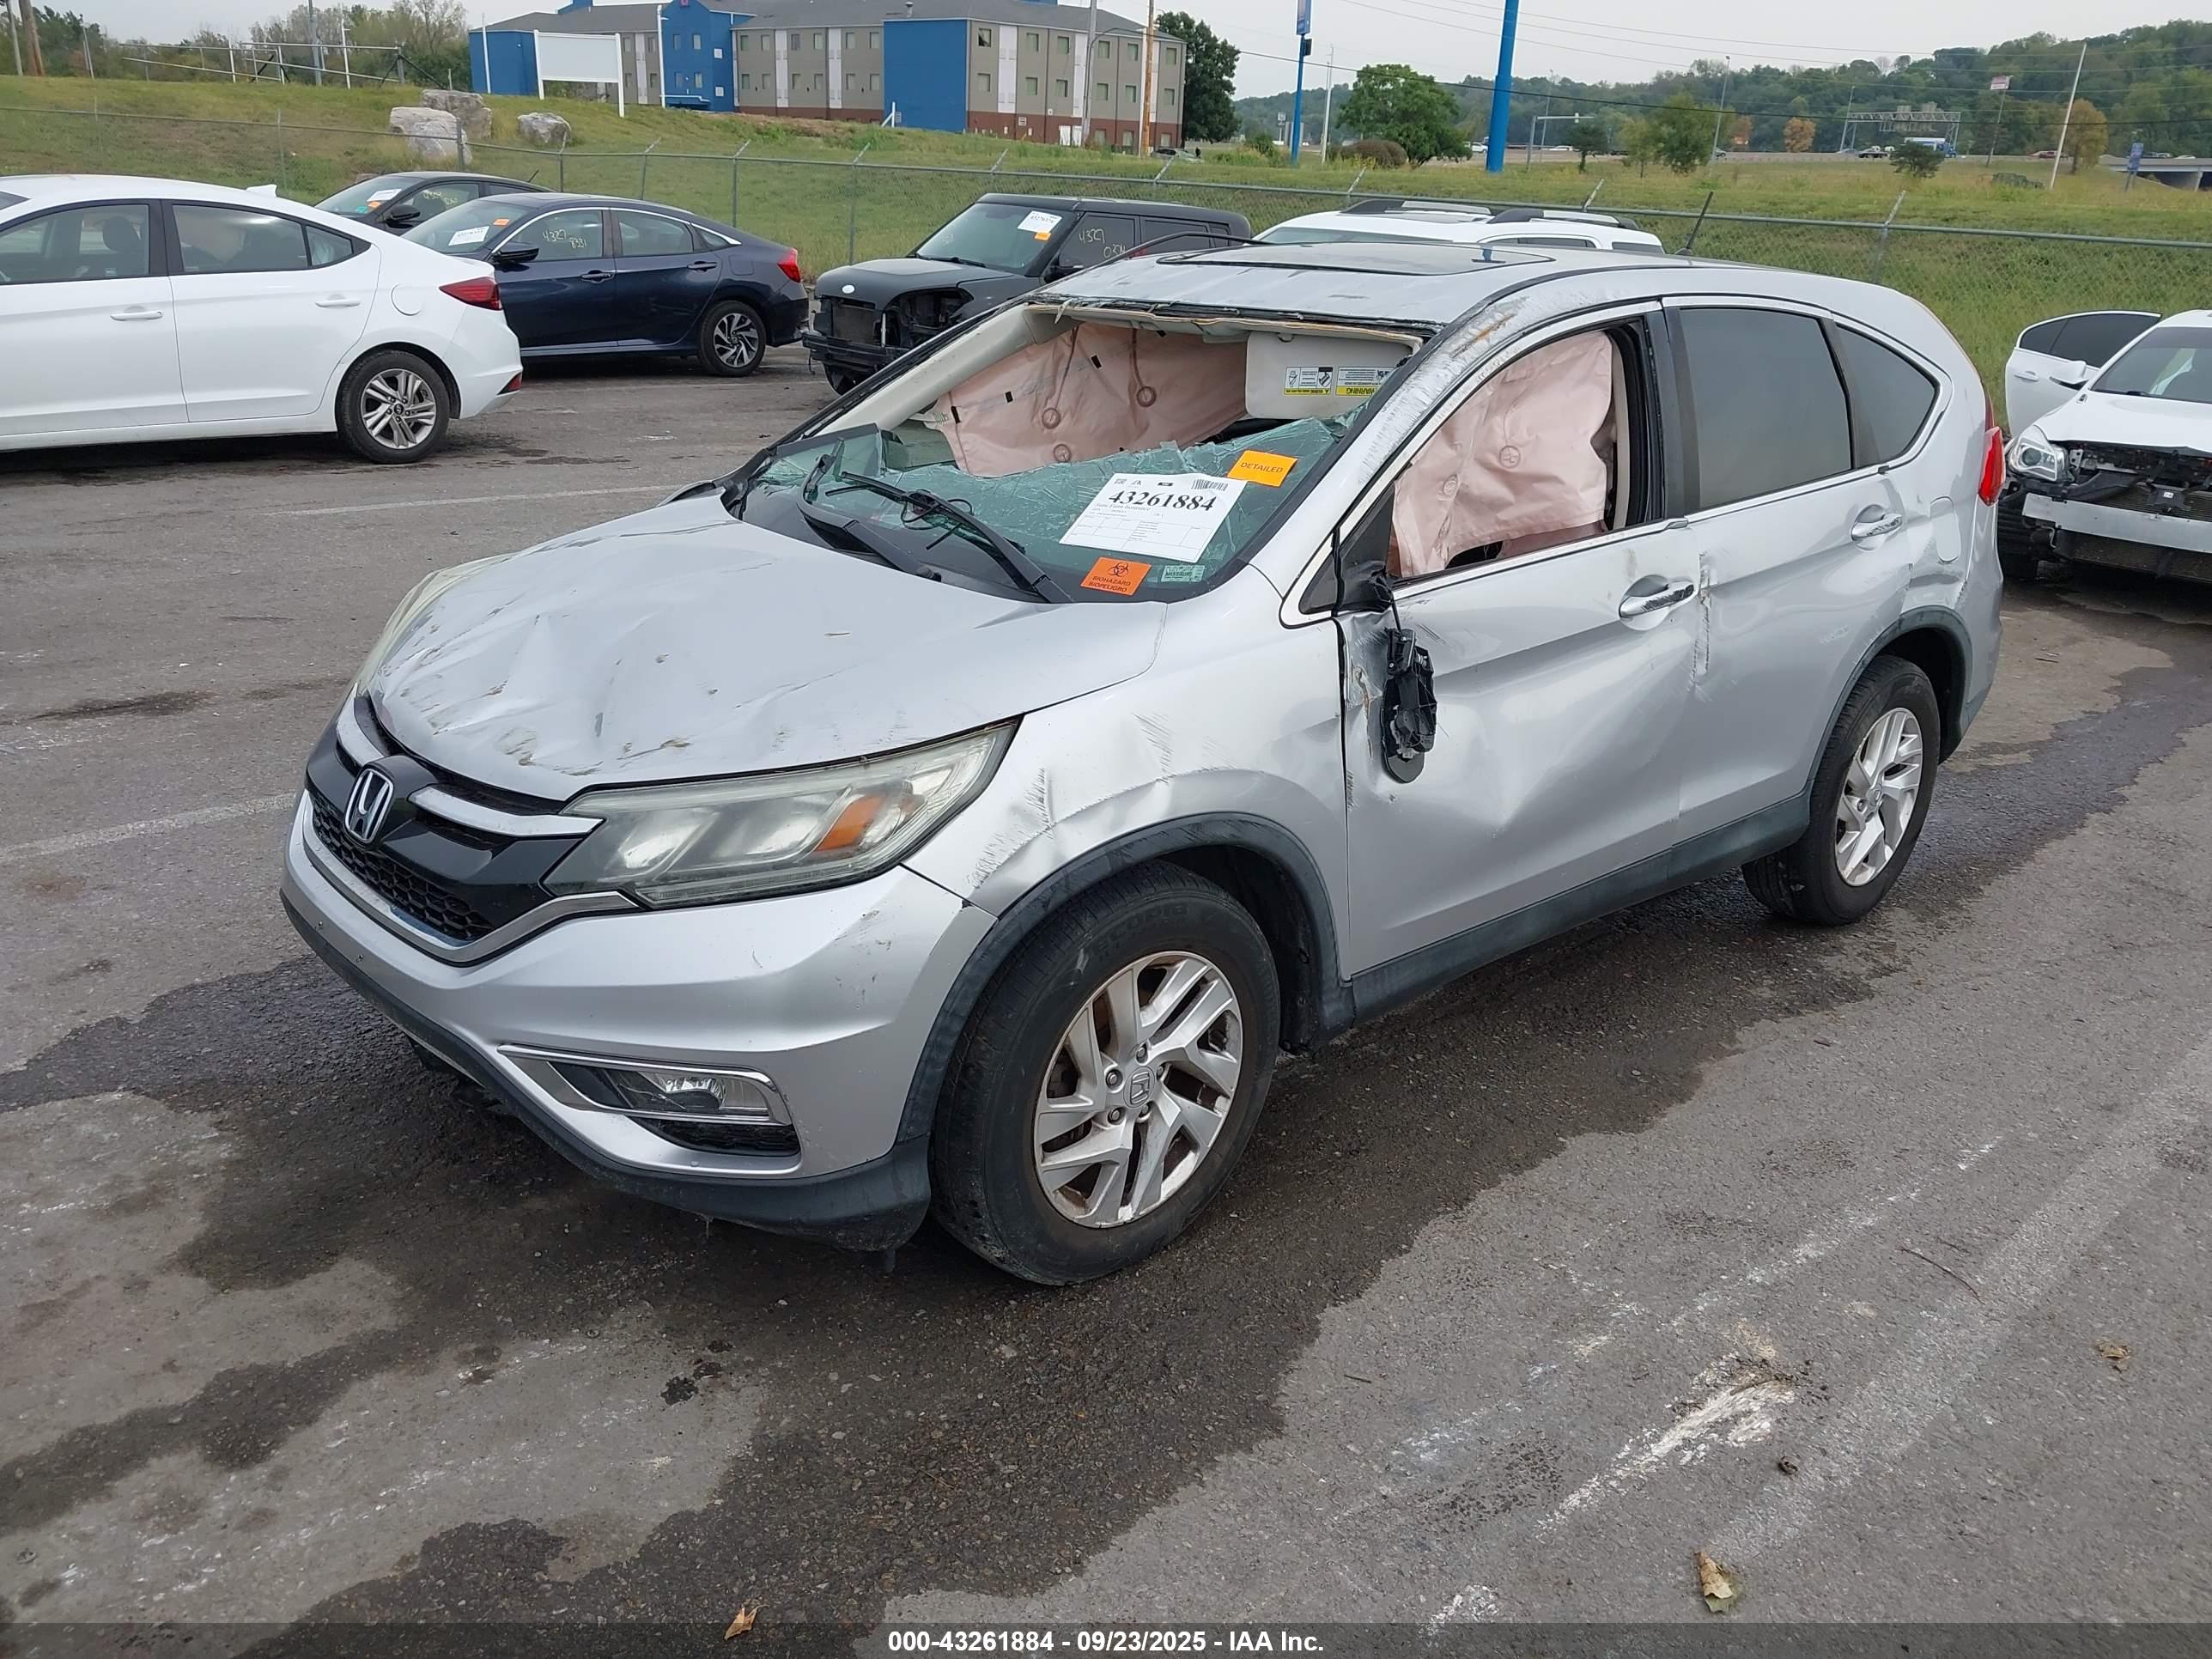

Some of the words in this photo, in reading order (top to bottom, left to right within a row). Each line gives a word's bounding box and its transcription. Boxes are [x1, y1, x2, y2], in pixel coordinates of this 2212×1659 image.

[543, 228, 567, 242] 4327
[1079, 228, 1105, 245] 4327
[1240, 461, 1284, 473] DETAILED
[1108, 490, 1218, 512] 43261884
[1088, 581, 1127, 592] BIOPELIGRO
[1091, 575, 1131, 587] BIOHAZARD
